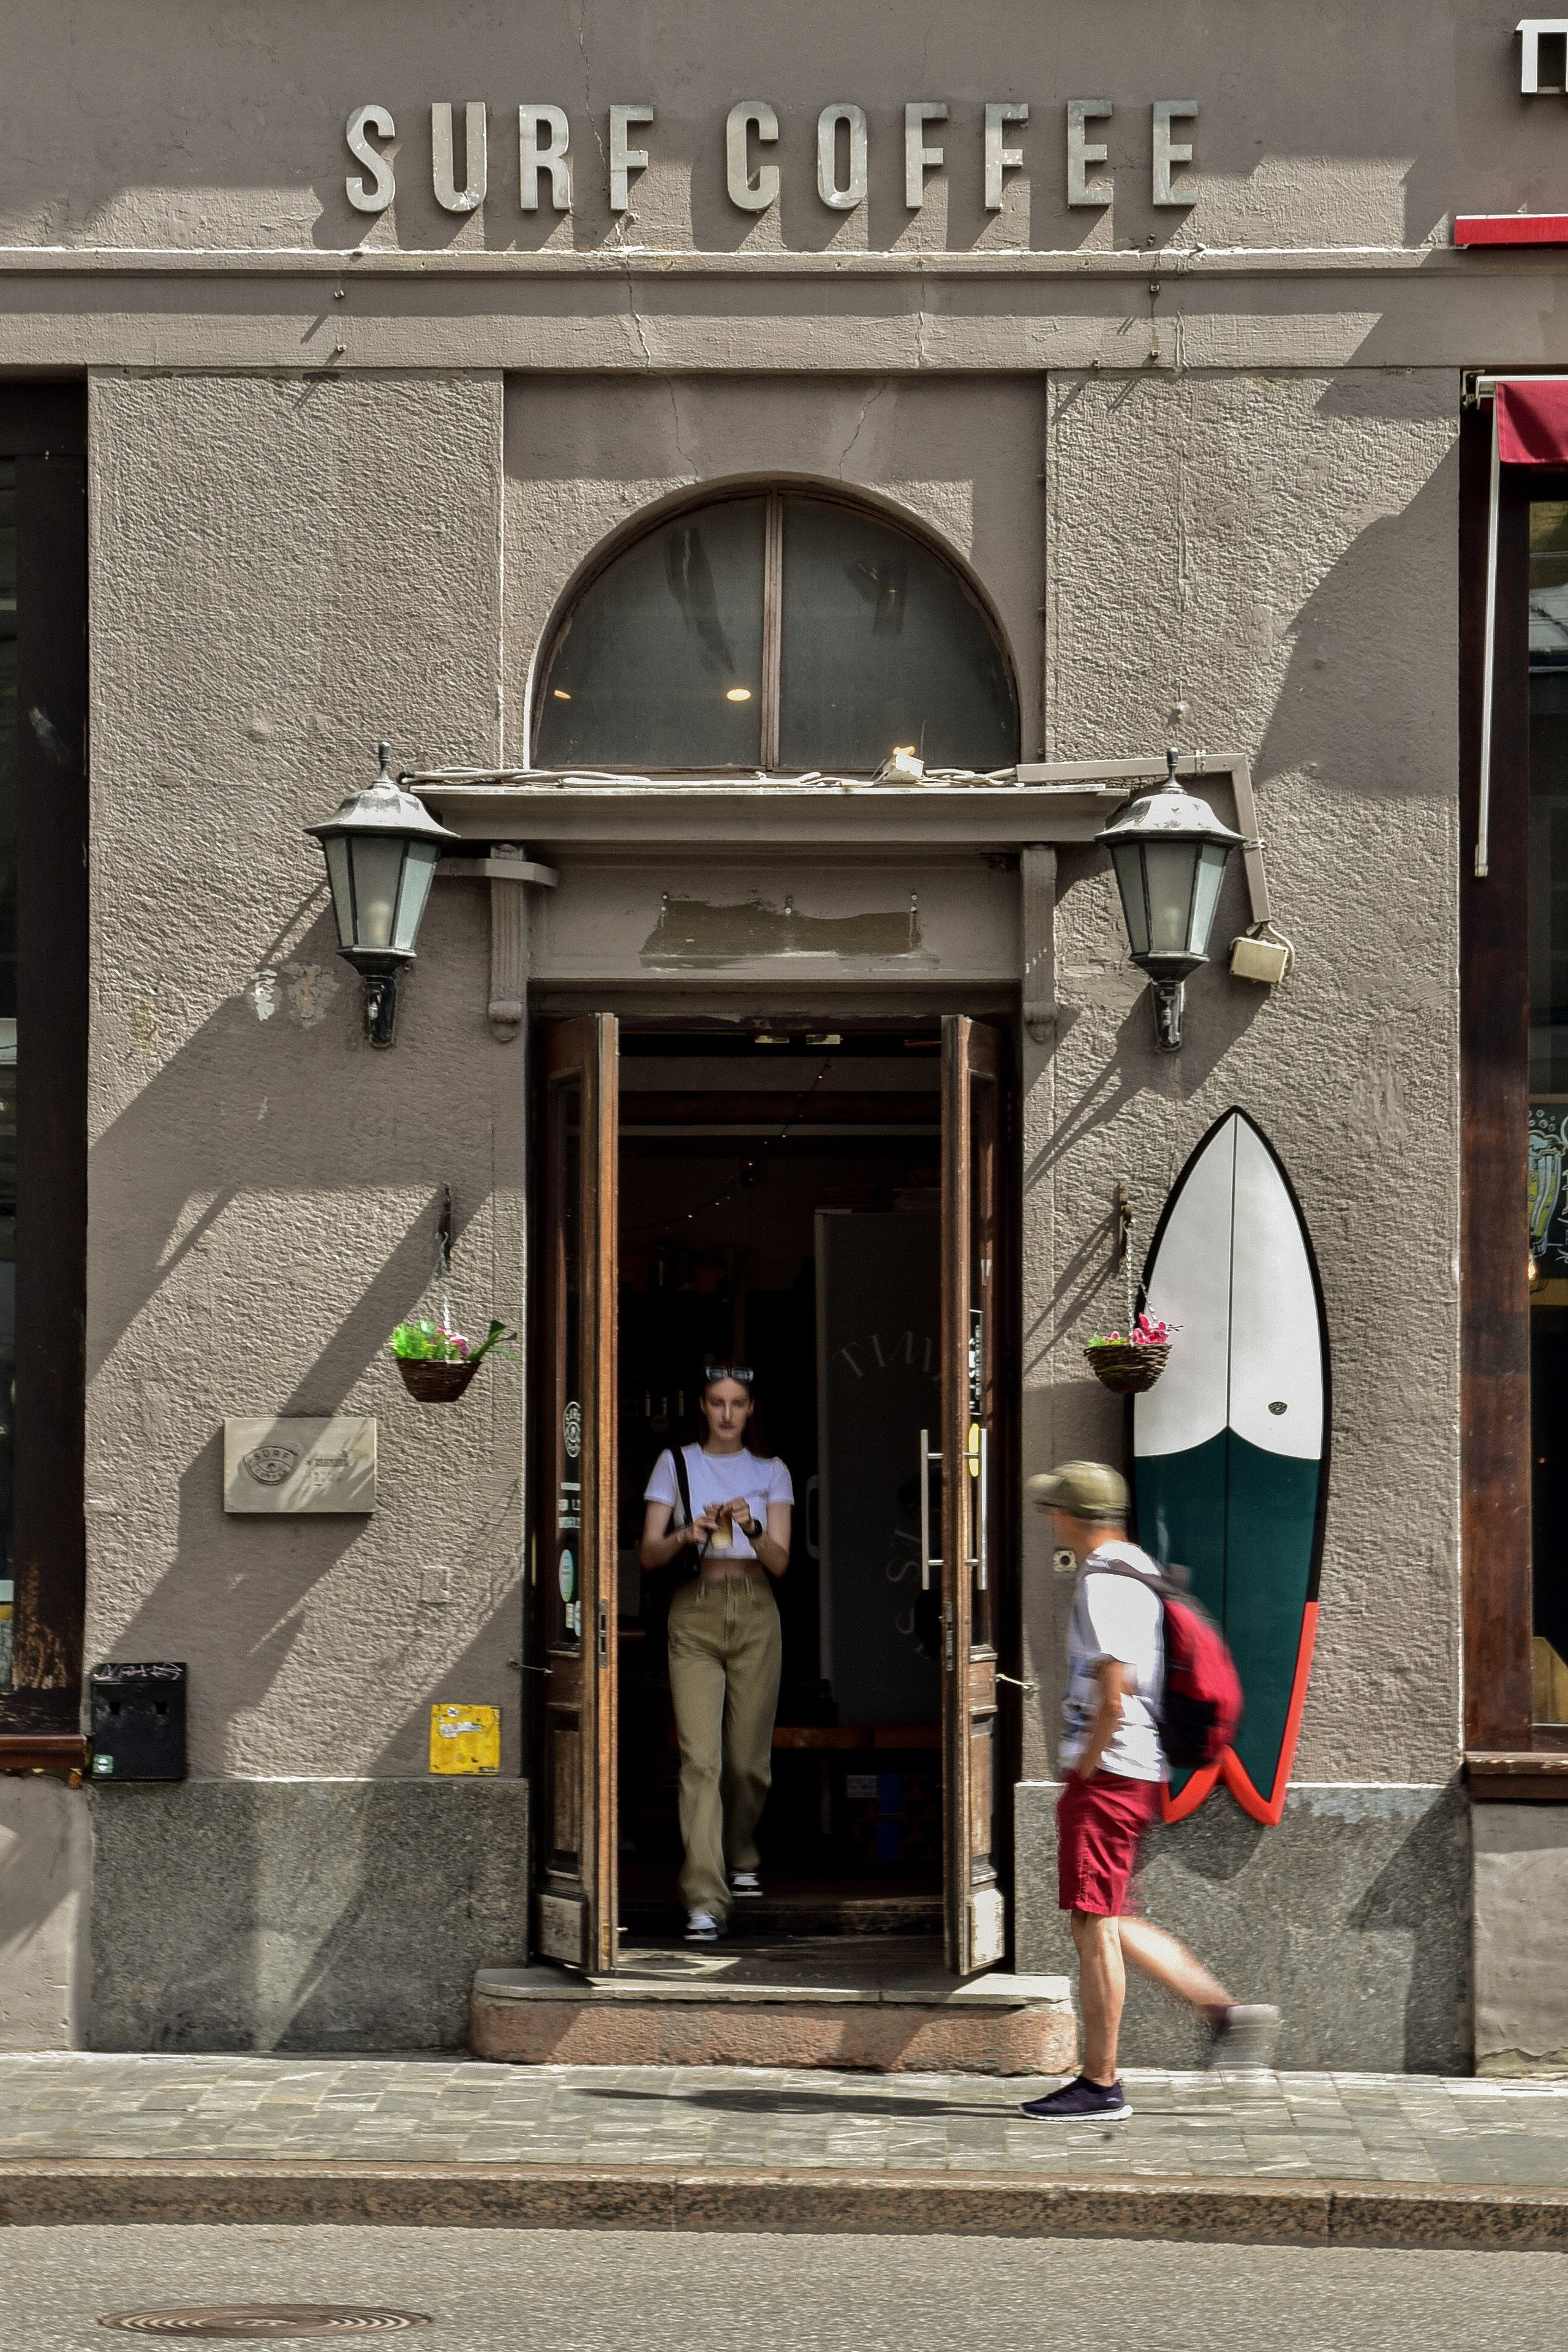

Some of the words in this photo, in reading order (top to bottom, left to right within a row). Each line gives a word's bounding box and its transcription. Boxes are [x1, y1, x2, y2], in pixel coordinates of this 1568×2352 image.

[345, 102, 654, 213] SURF
[726, 100, 1198, 211] COFFEE
[253, 1449, 290, 1461] SURF
